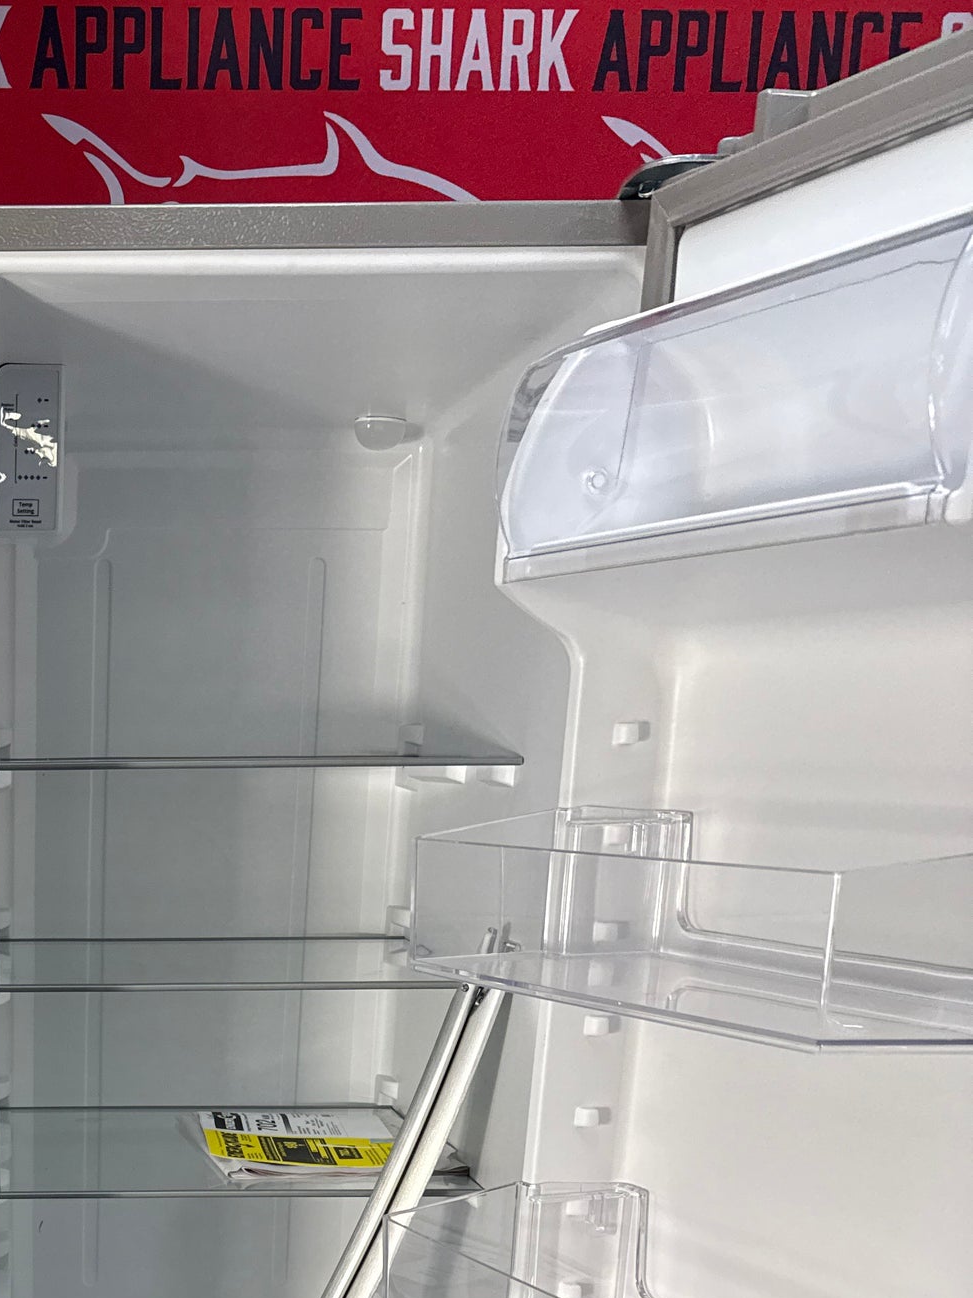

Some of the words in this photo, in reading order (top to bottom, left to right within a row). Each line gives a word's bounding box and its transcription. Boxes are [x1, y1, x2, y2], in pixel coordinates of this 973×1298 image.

[29, 5, 362, 91] APPLIANCE
[379, 9, 575, 93] SHARK
[256, 1119, 278, 1131] 702
